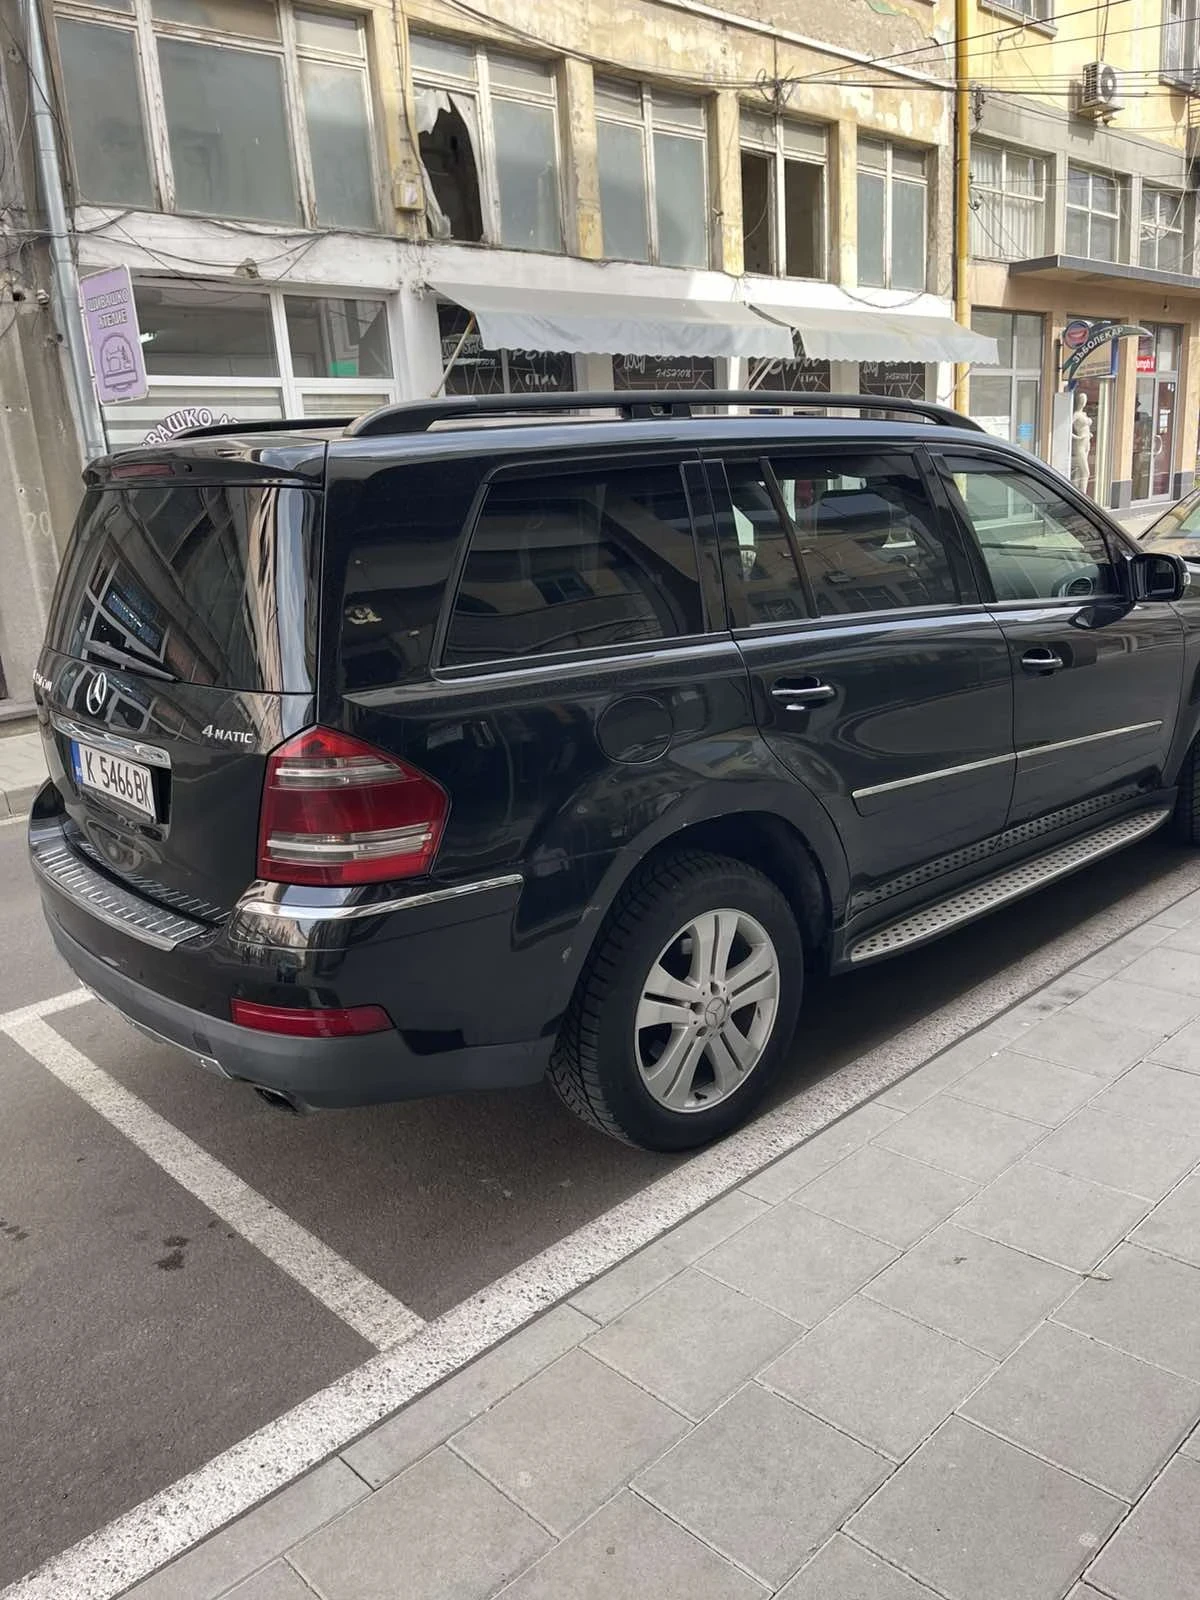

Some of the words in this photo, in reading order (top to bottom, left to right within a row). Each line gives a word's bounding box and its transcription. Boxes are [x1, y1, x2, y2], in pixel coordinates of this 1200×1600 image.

[1072, 326, 1124, 363] ЗЪБОЛЕКАР
[141, 408, 213, 447] ВАШКО
[201, 724, 254, 744] 4MATIC
[85, 750, 97, 783] K
